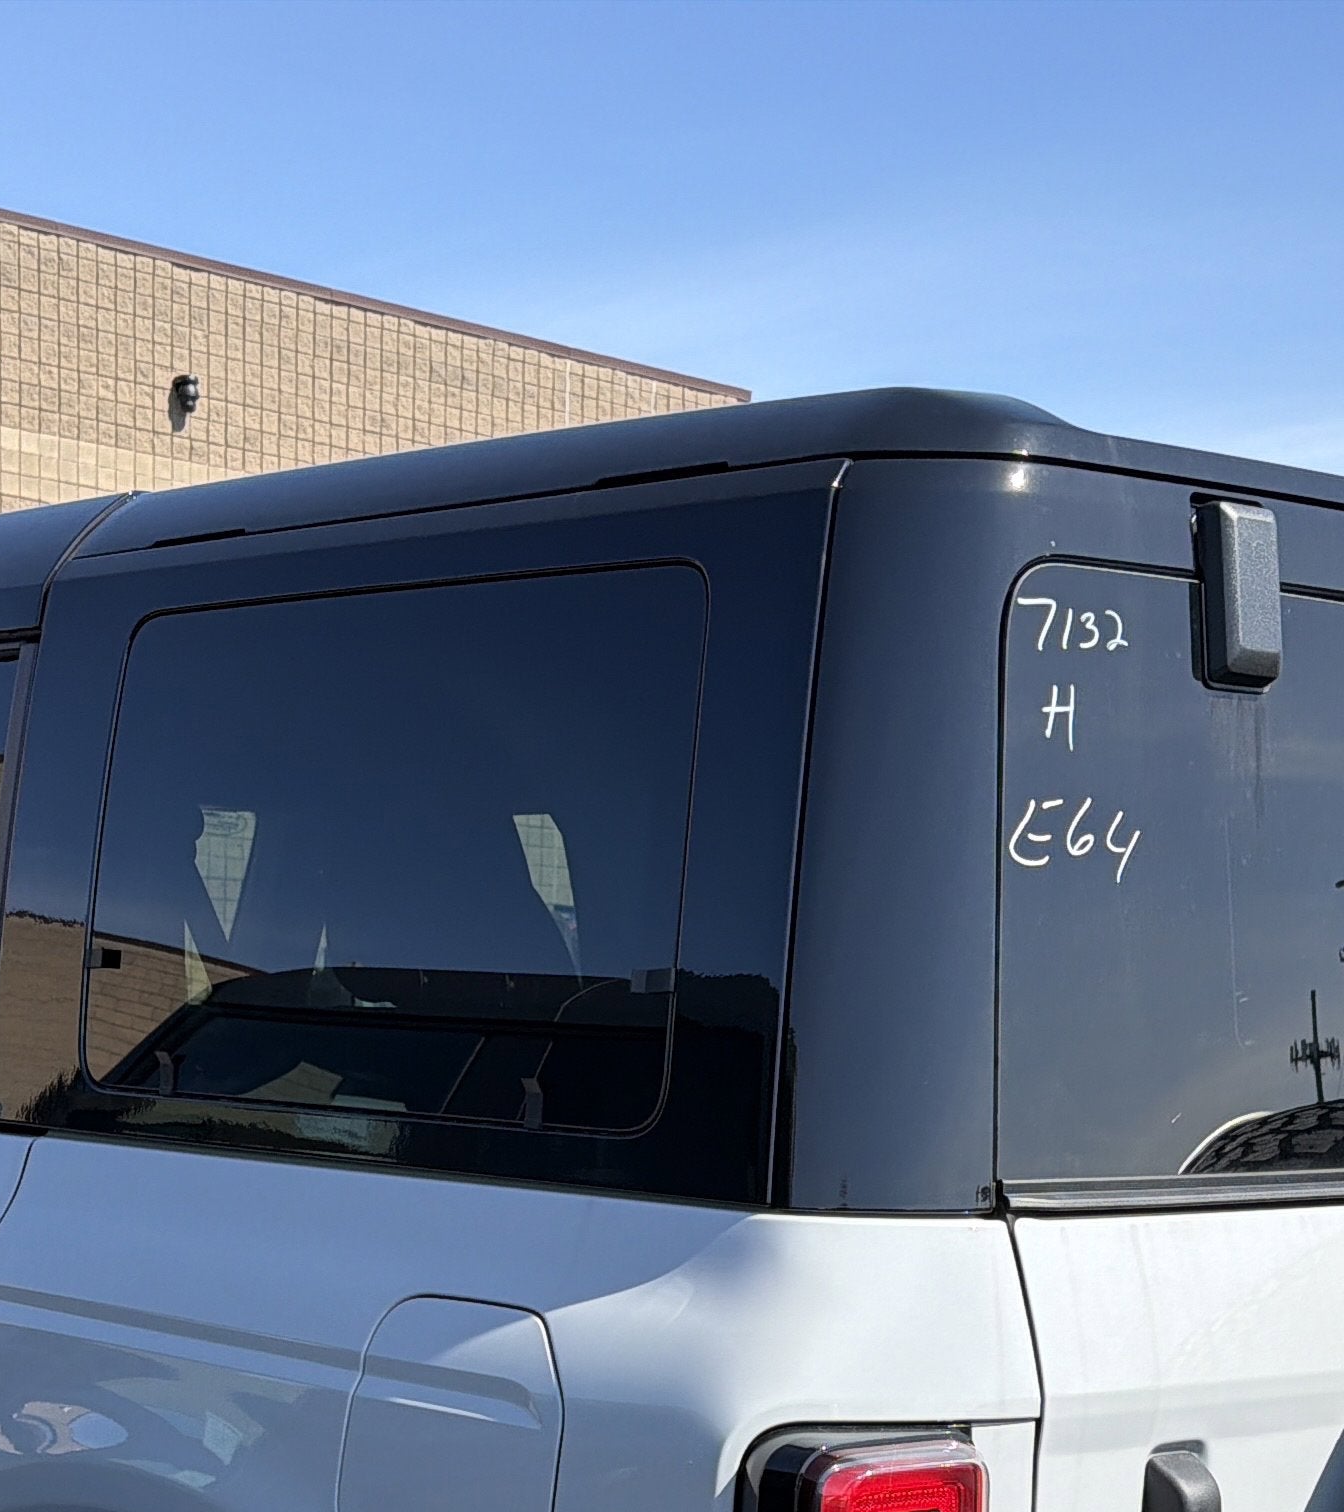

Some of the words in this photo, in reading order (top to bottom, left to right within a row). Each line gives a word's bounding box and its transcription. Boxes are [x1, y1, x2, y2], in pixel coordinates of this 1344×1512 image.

[1017, 598, 1129, 652] 7132
[1041, 684, 1076, 752] H
[1009, 797, 1142, 884] E64
